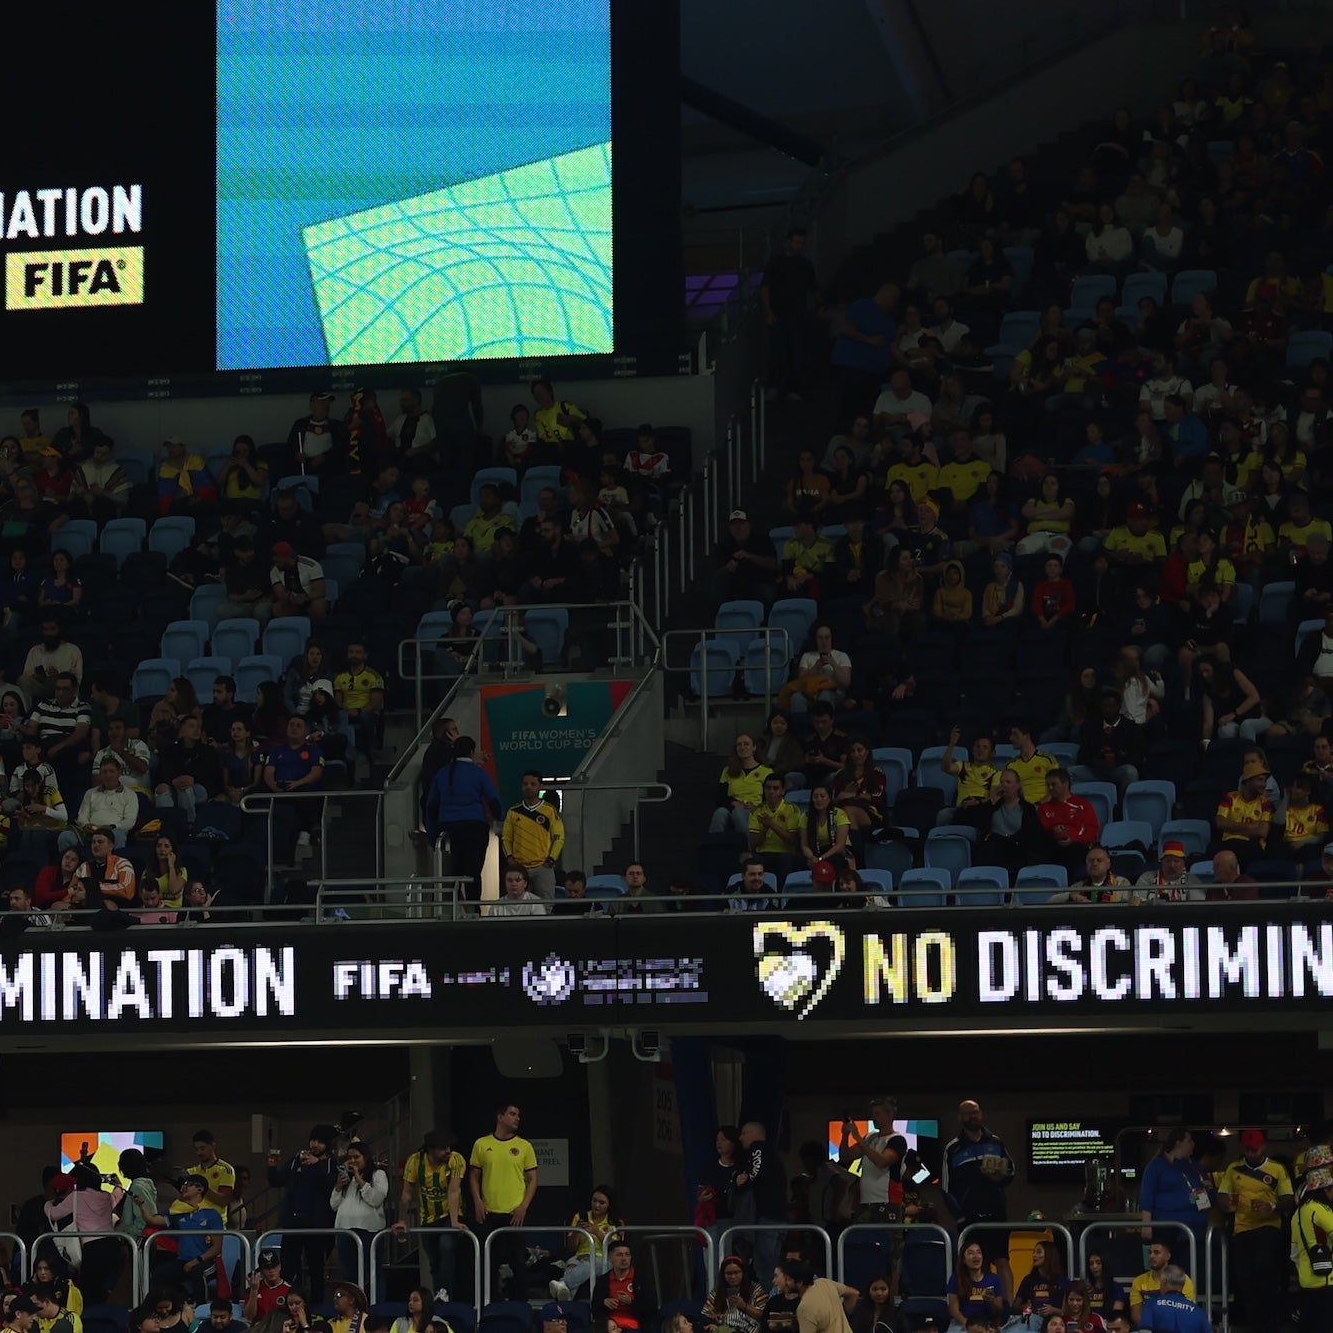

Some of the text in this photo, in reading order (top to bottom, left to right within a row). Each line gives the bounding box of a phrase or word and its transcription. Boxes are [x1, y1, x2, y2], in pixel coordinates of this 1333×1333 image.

[511, 729, 596, 740] FIFA WOMEN'S
[499, 740, 543, 751] WORLD
[547, 740, 571, 749] CUP
[863, 931, 956, 1004] NO
[333, 961, 432, 999] FIFA
[1157, 1299, 1195, 1312] SECURITY
